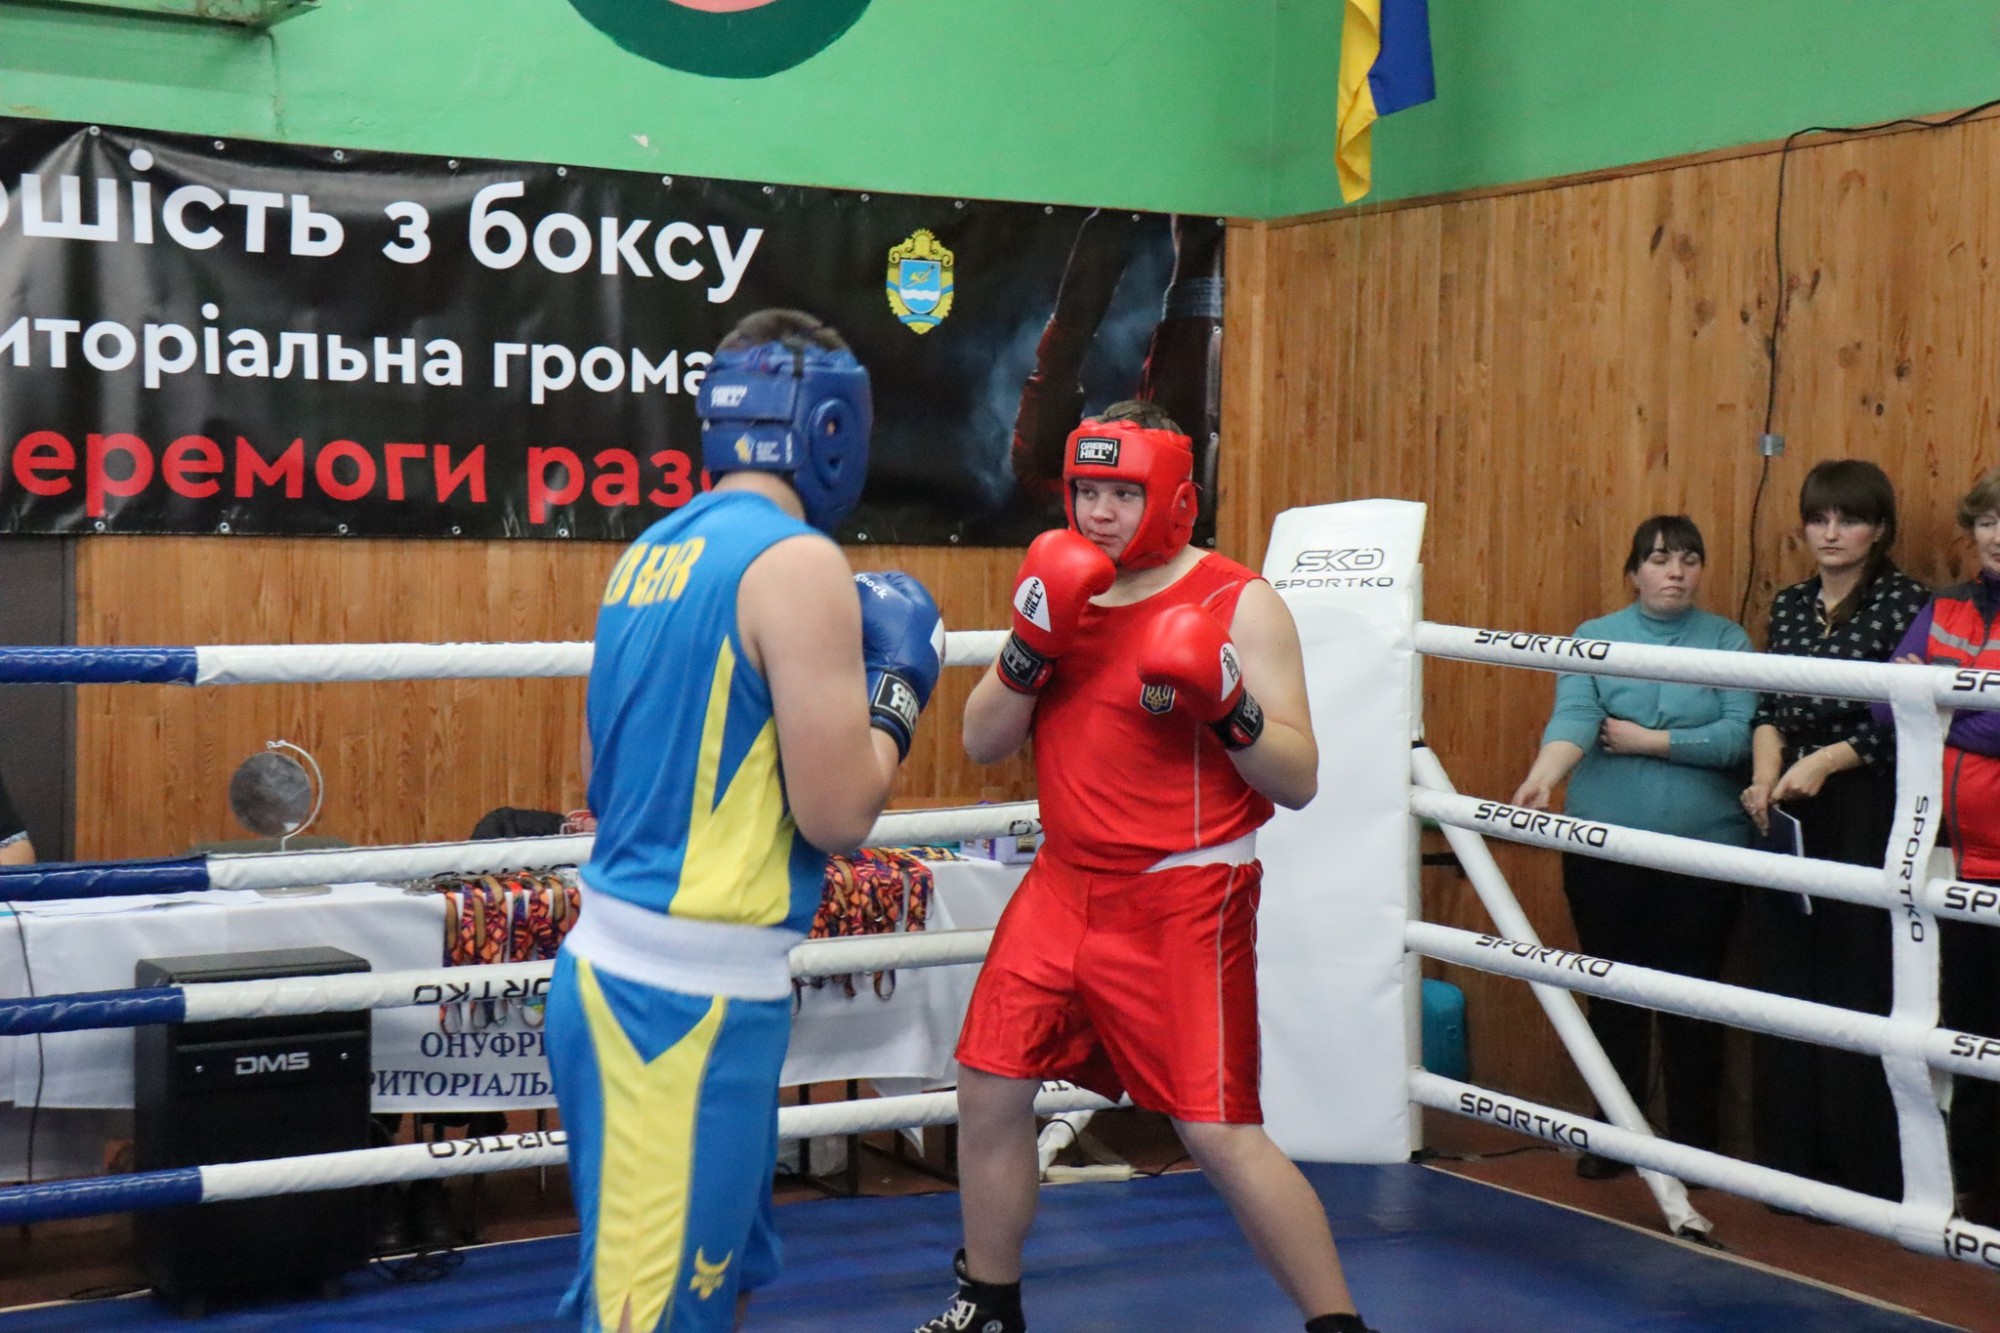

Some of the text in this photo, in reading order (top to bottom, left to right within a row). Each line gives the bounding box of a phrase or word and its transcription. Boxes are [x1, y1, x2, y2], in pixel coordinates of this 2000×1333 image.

[0, 149, 764, 303] шість з боксу
[1081, 442, 1113, 451] GREEN
[12, 431, 711, 524] еремоги раз
[1291, 548, 1384, 573] SKO
[1022, 579, 1040, 616] GREEN
[1274, 577, 1394, 590] SPORTKO
[1026, 592, 1043, 620] HILL
[1474, 630, 1611, 660] SPORTKO
[1474, 803, 1608, 848] SPORTKO
[1899, 795, 1929, 943] SPORTKO
[1944, 886, 2000, 912] SP
[1475, 935, 1614, 977] SPORTKO
[236, 1052, 310, 1075] DMS
[370, 1070, 556, 1097] ИТОРІАЛЬ
[1460, 1092, 1589, 1149] SPORTKO
